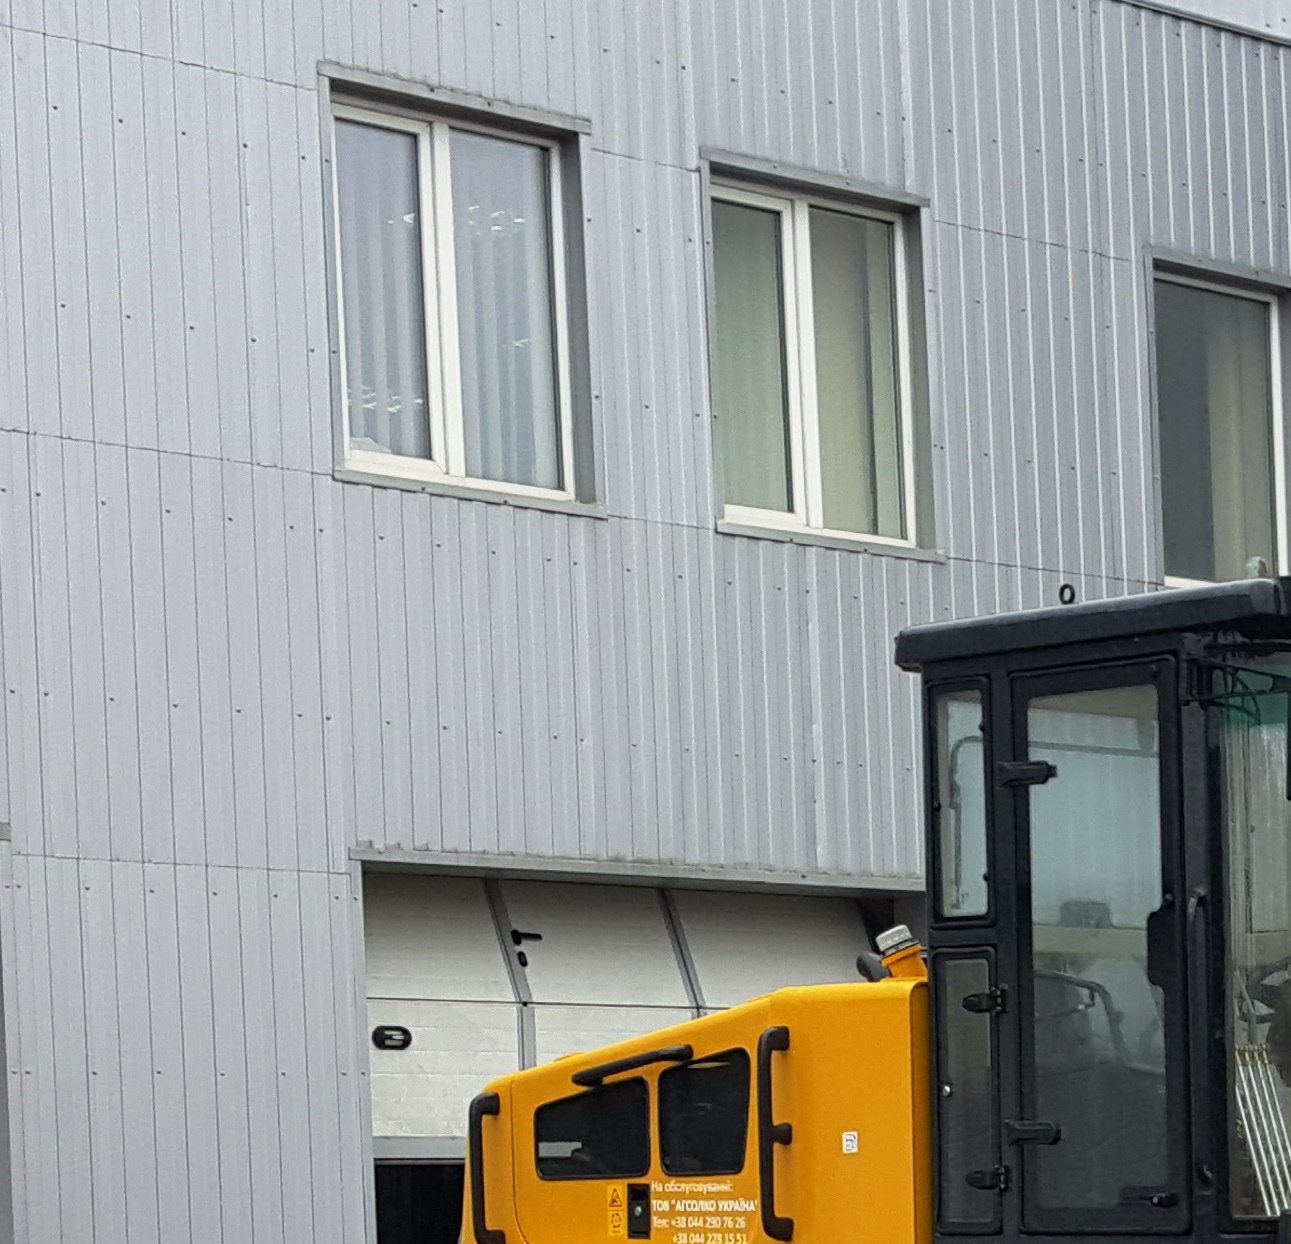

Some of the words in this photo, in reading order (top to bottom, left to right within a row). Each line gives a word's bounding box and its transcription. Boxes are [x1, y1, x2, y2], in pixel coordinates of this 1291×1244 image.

[651, 1181, 662, 1192] На
[652, 1200, 669, 1211] ТОВ
[671, 1217, 687, 1228] +38
[688, 1217, 703, 1228] 044
[673, 1233, 688, 1244] +38
[689, 1233, 704, 1244] 044
